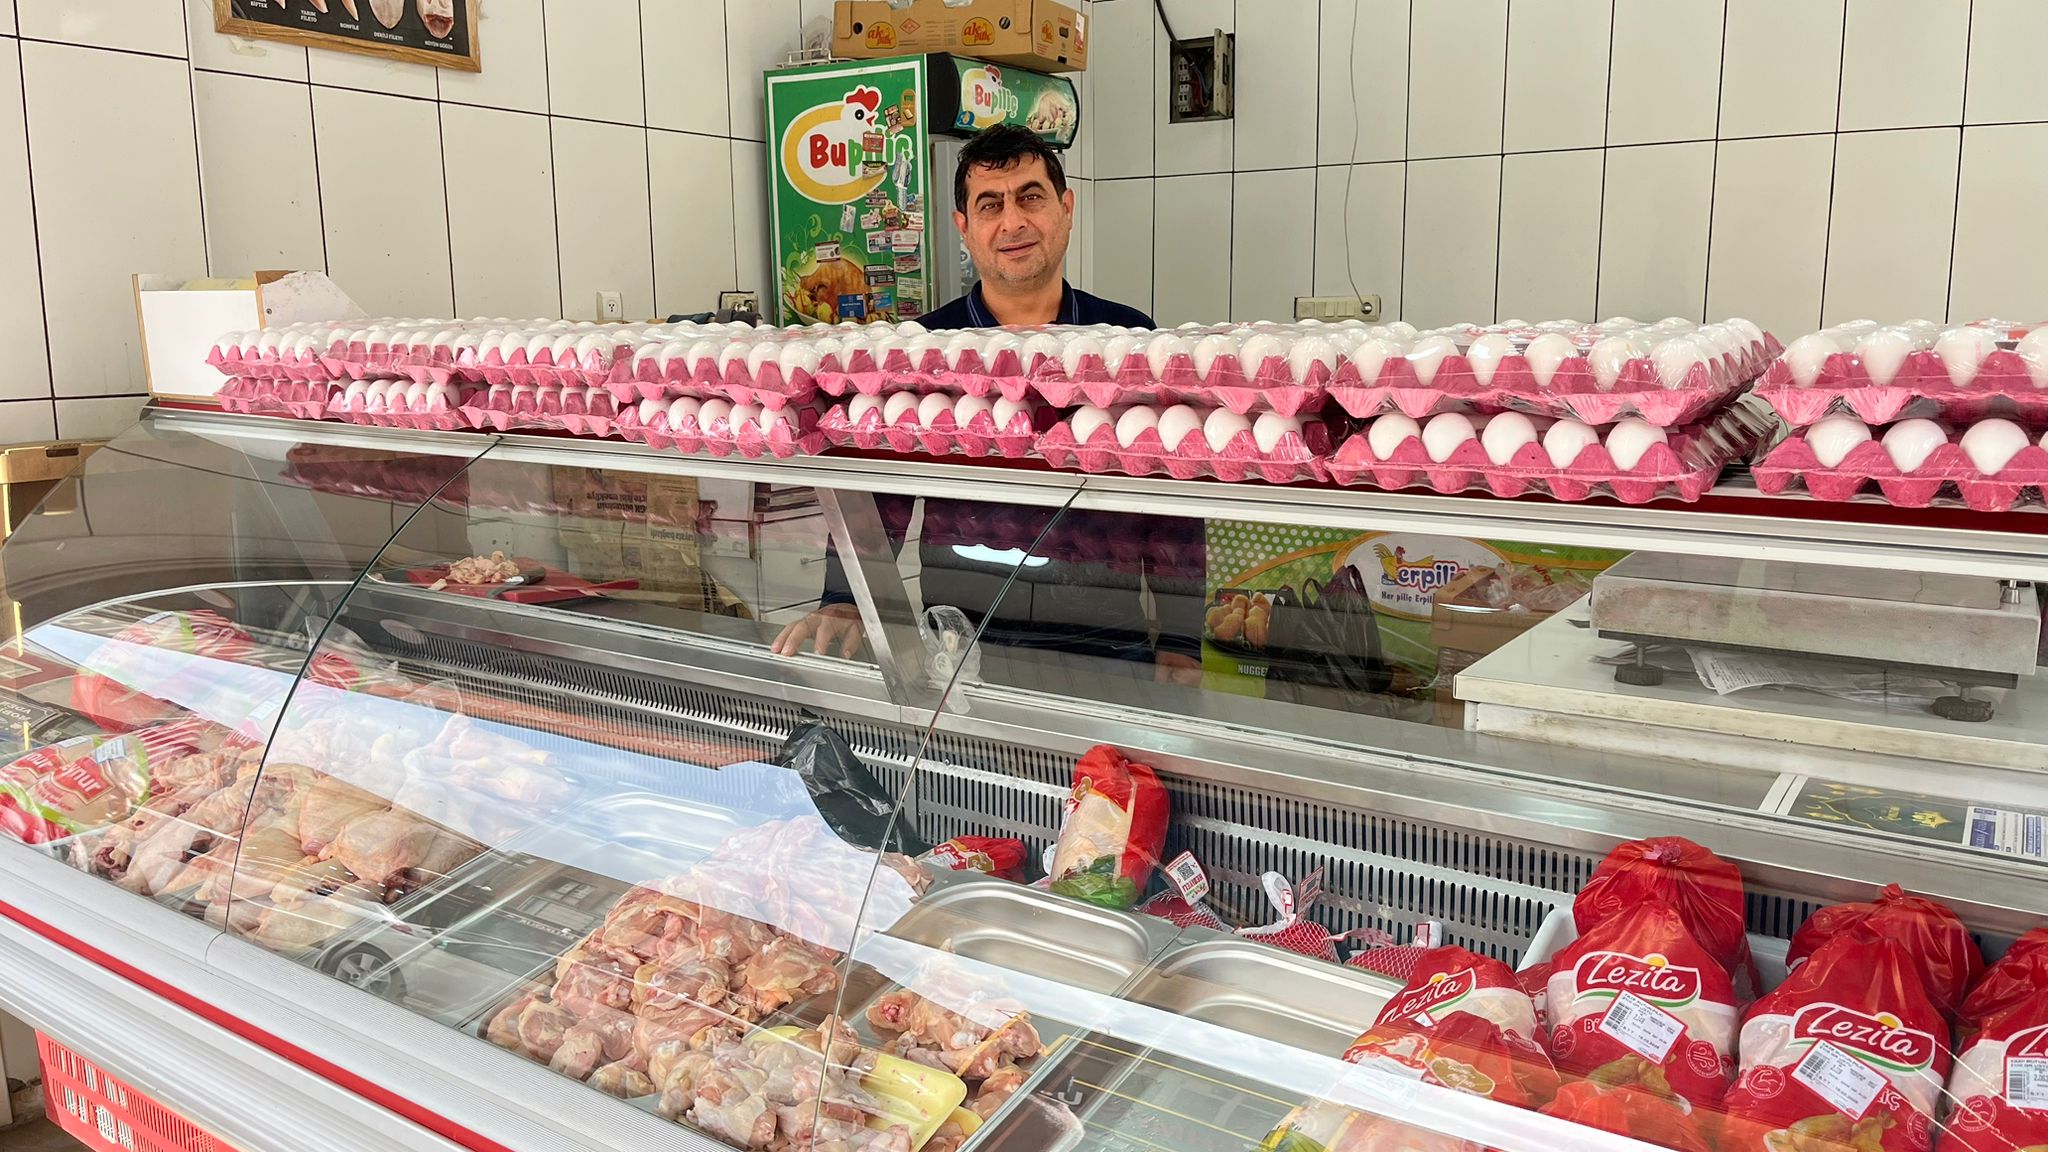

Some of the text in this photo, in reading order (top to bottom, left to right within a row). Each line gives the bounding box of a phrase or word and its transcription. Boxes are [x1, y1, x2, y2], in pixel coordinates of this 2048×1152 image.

[974, 84, 1018, 118] Bupiliç
[1399, 564, 1456, 589] erpili
[1415, 594, 1433, 605] Erpil
[1238, 664, 1269, 677] NUGGE
[1586, 954, 1686, 993] Lezita
[1381, 976, 1463, 1026] Lezita
[1806, 1007, 1919, 1057] Lezita
